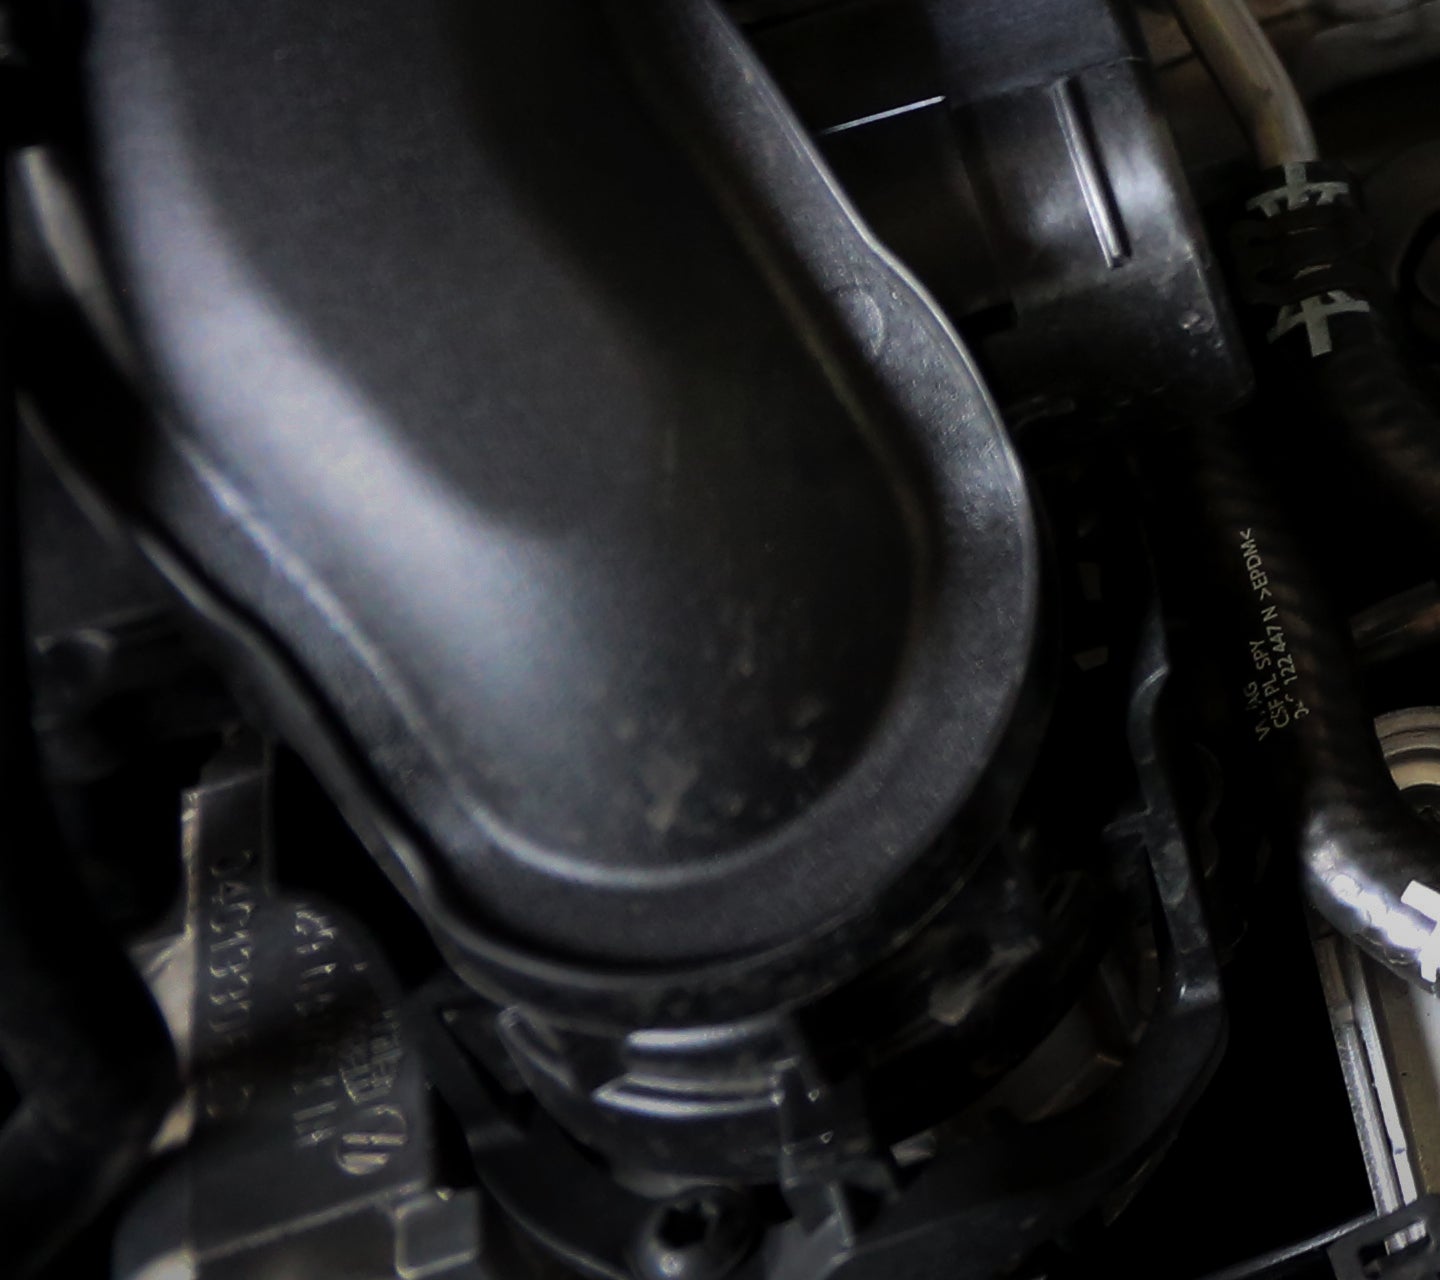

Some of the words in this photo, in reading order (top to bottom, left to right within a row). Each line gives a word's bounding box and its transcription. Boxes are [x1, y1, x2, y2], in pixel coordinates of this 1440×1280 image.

[1261, 604, 1278, 621] N
[1266, 625, 1287, 652] 447
[1248, 638, 1273, 670] SPY
[1277, 653, 1298, 685] 122
[1262, 673, 1280, 697] PL
[1266, 698, 1290, 728] CSF
